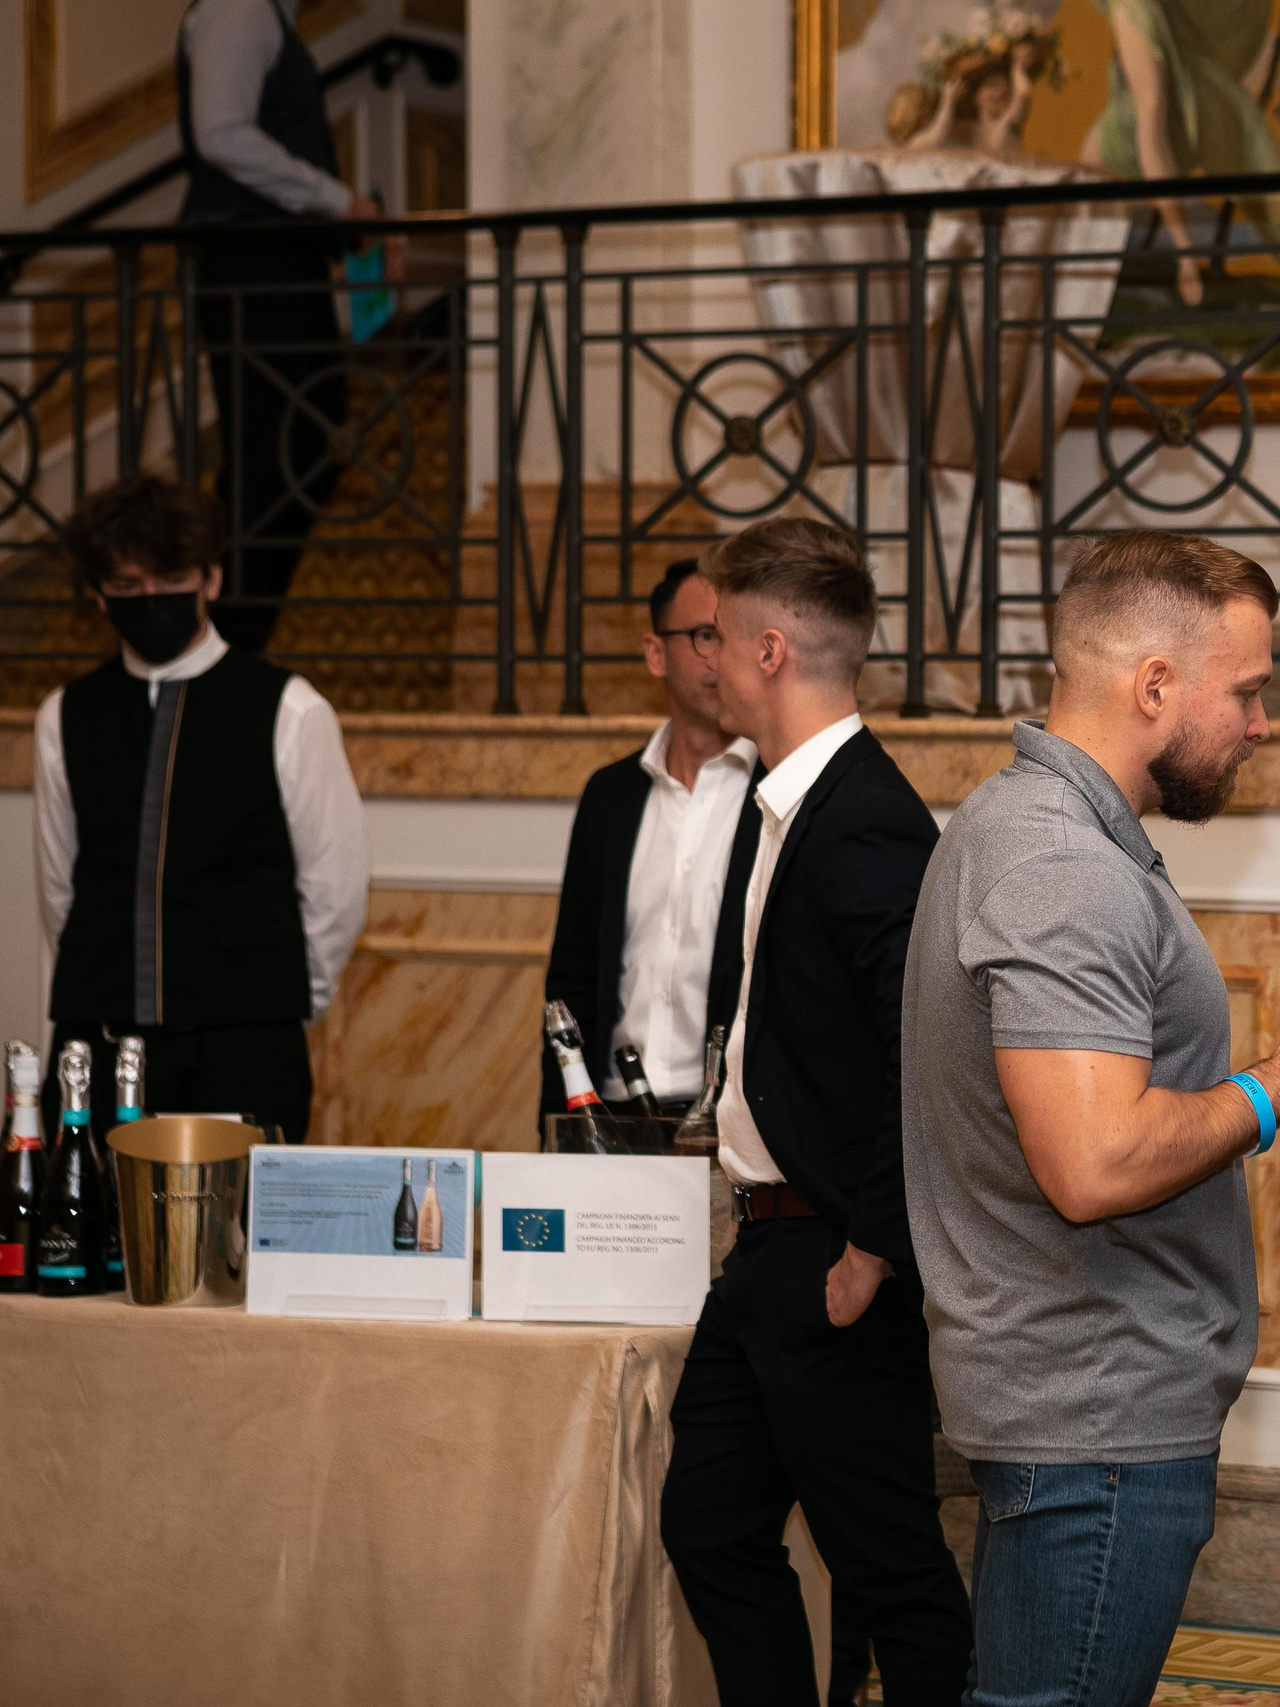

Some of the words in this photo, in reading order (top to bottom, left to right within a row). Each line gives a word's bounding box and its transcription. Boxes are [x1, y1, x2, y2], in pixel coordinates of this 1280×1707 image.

[576, 1212, 614, 1220] CAMPAGNA
[576, 1235, 612, 1243] CAMPAIGN
[613, 1236, 646, 1244] FINANCED
[647, 1237, 686, 1245] ACCORDING
